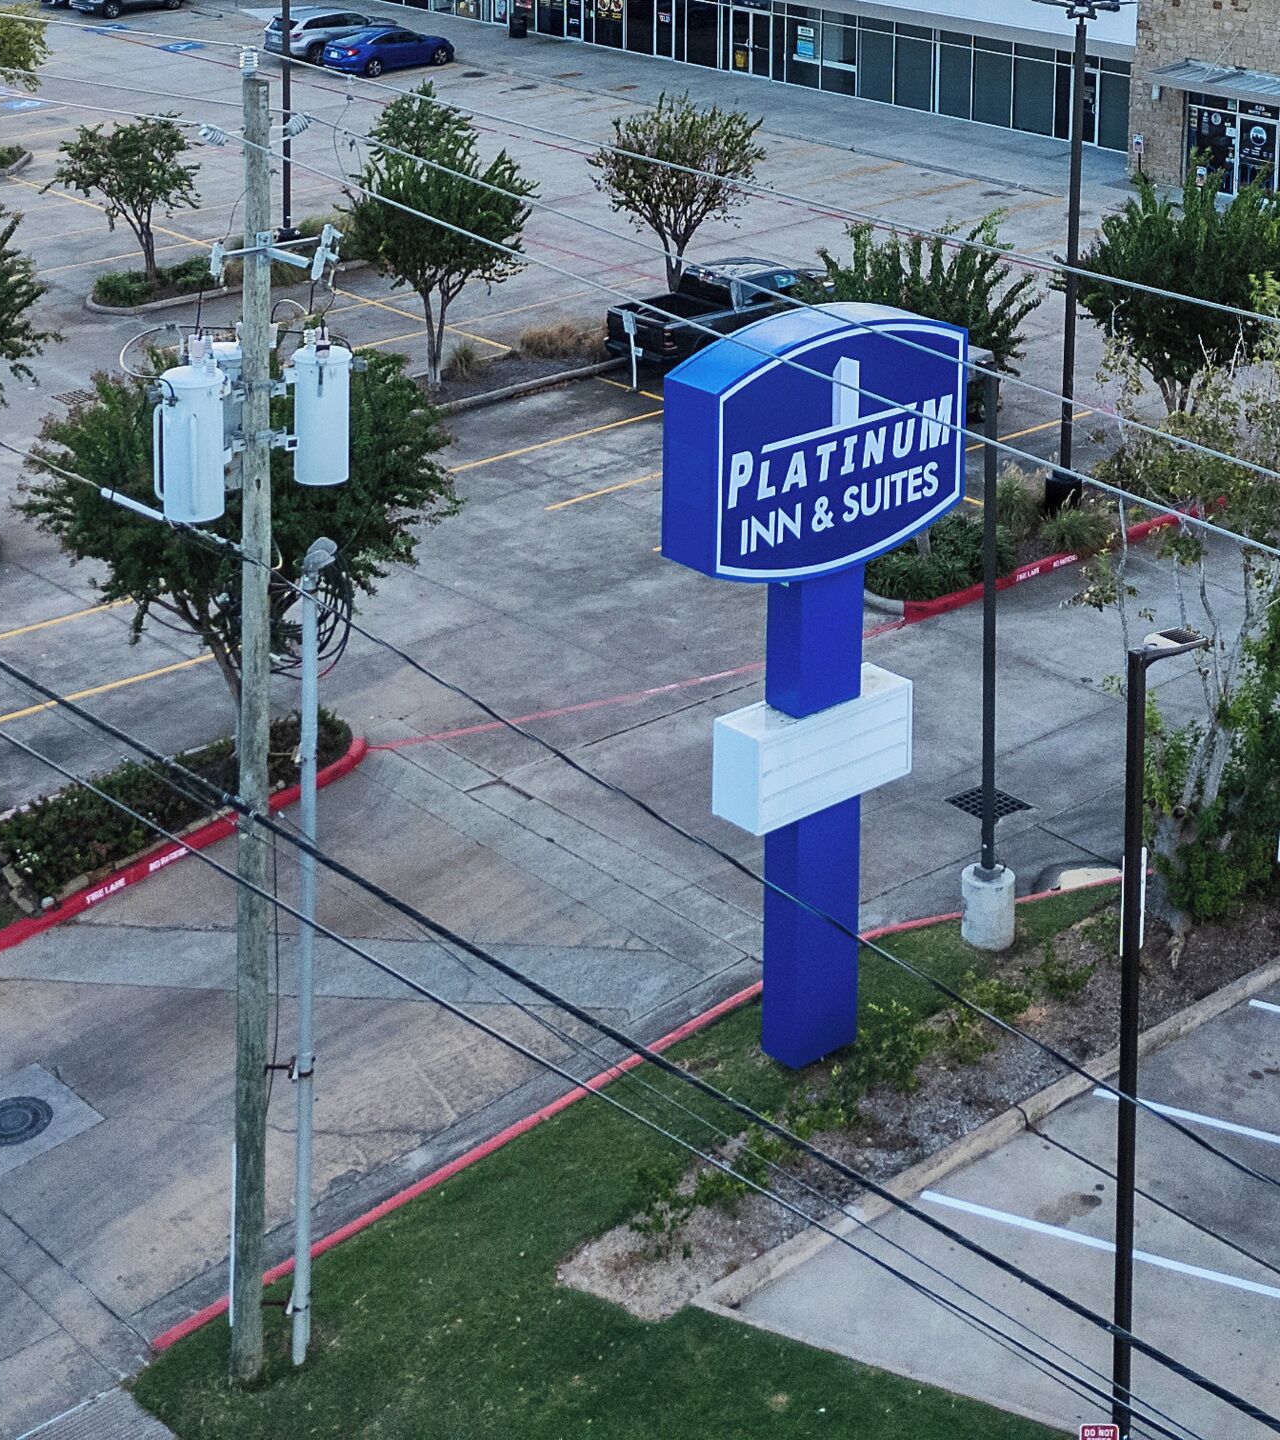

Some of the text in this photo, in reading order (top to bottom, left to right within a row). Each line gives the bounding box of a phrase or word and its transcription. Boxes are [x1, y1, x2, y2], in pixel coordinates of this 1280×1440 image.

[727, 394, 953, 509] PLATINUM
[740, 461, 939, 556] INN & SUITES
[1084, 1428, 1114, 1437] DO NOT
